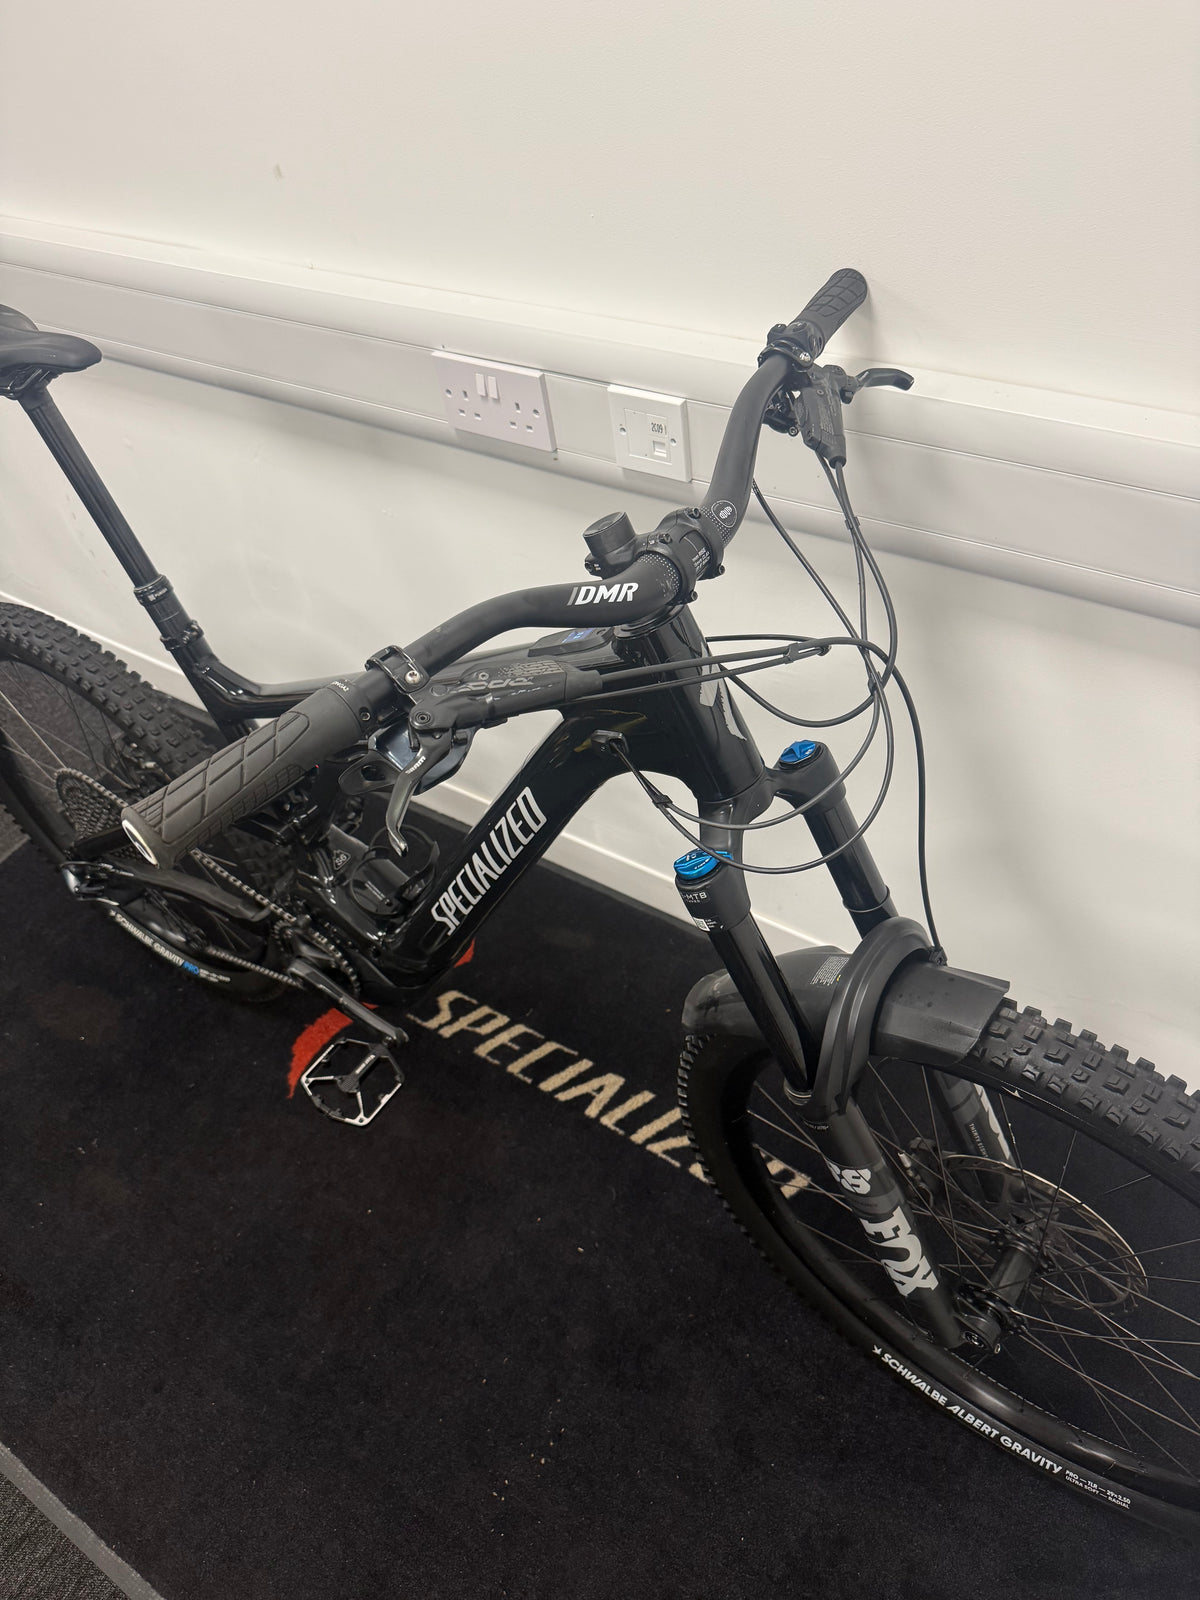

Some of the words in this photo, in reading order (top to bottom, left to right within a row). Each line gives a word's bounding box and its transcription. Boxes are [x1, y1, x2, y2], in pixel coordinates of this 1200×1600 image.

[572, 581, 639, 606] DMR
[430, 786, 547, 936] SPECIALIZED
[153, 942, 185, 966] GRAVITY
[182, 961, 200, 975] PRO
[406, 989, 812, 1200] SPECIALIZ
[859, 1205, 940, 1299] FOX
[881, 1352, 949, 1407] SCHWALBE
[946, 1404, 1000, 1439] ALBERT
[999, 1434, 1063, 1475] GRAVITY
